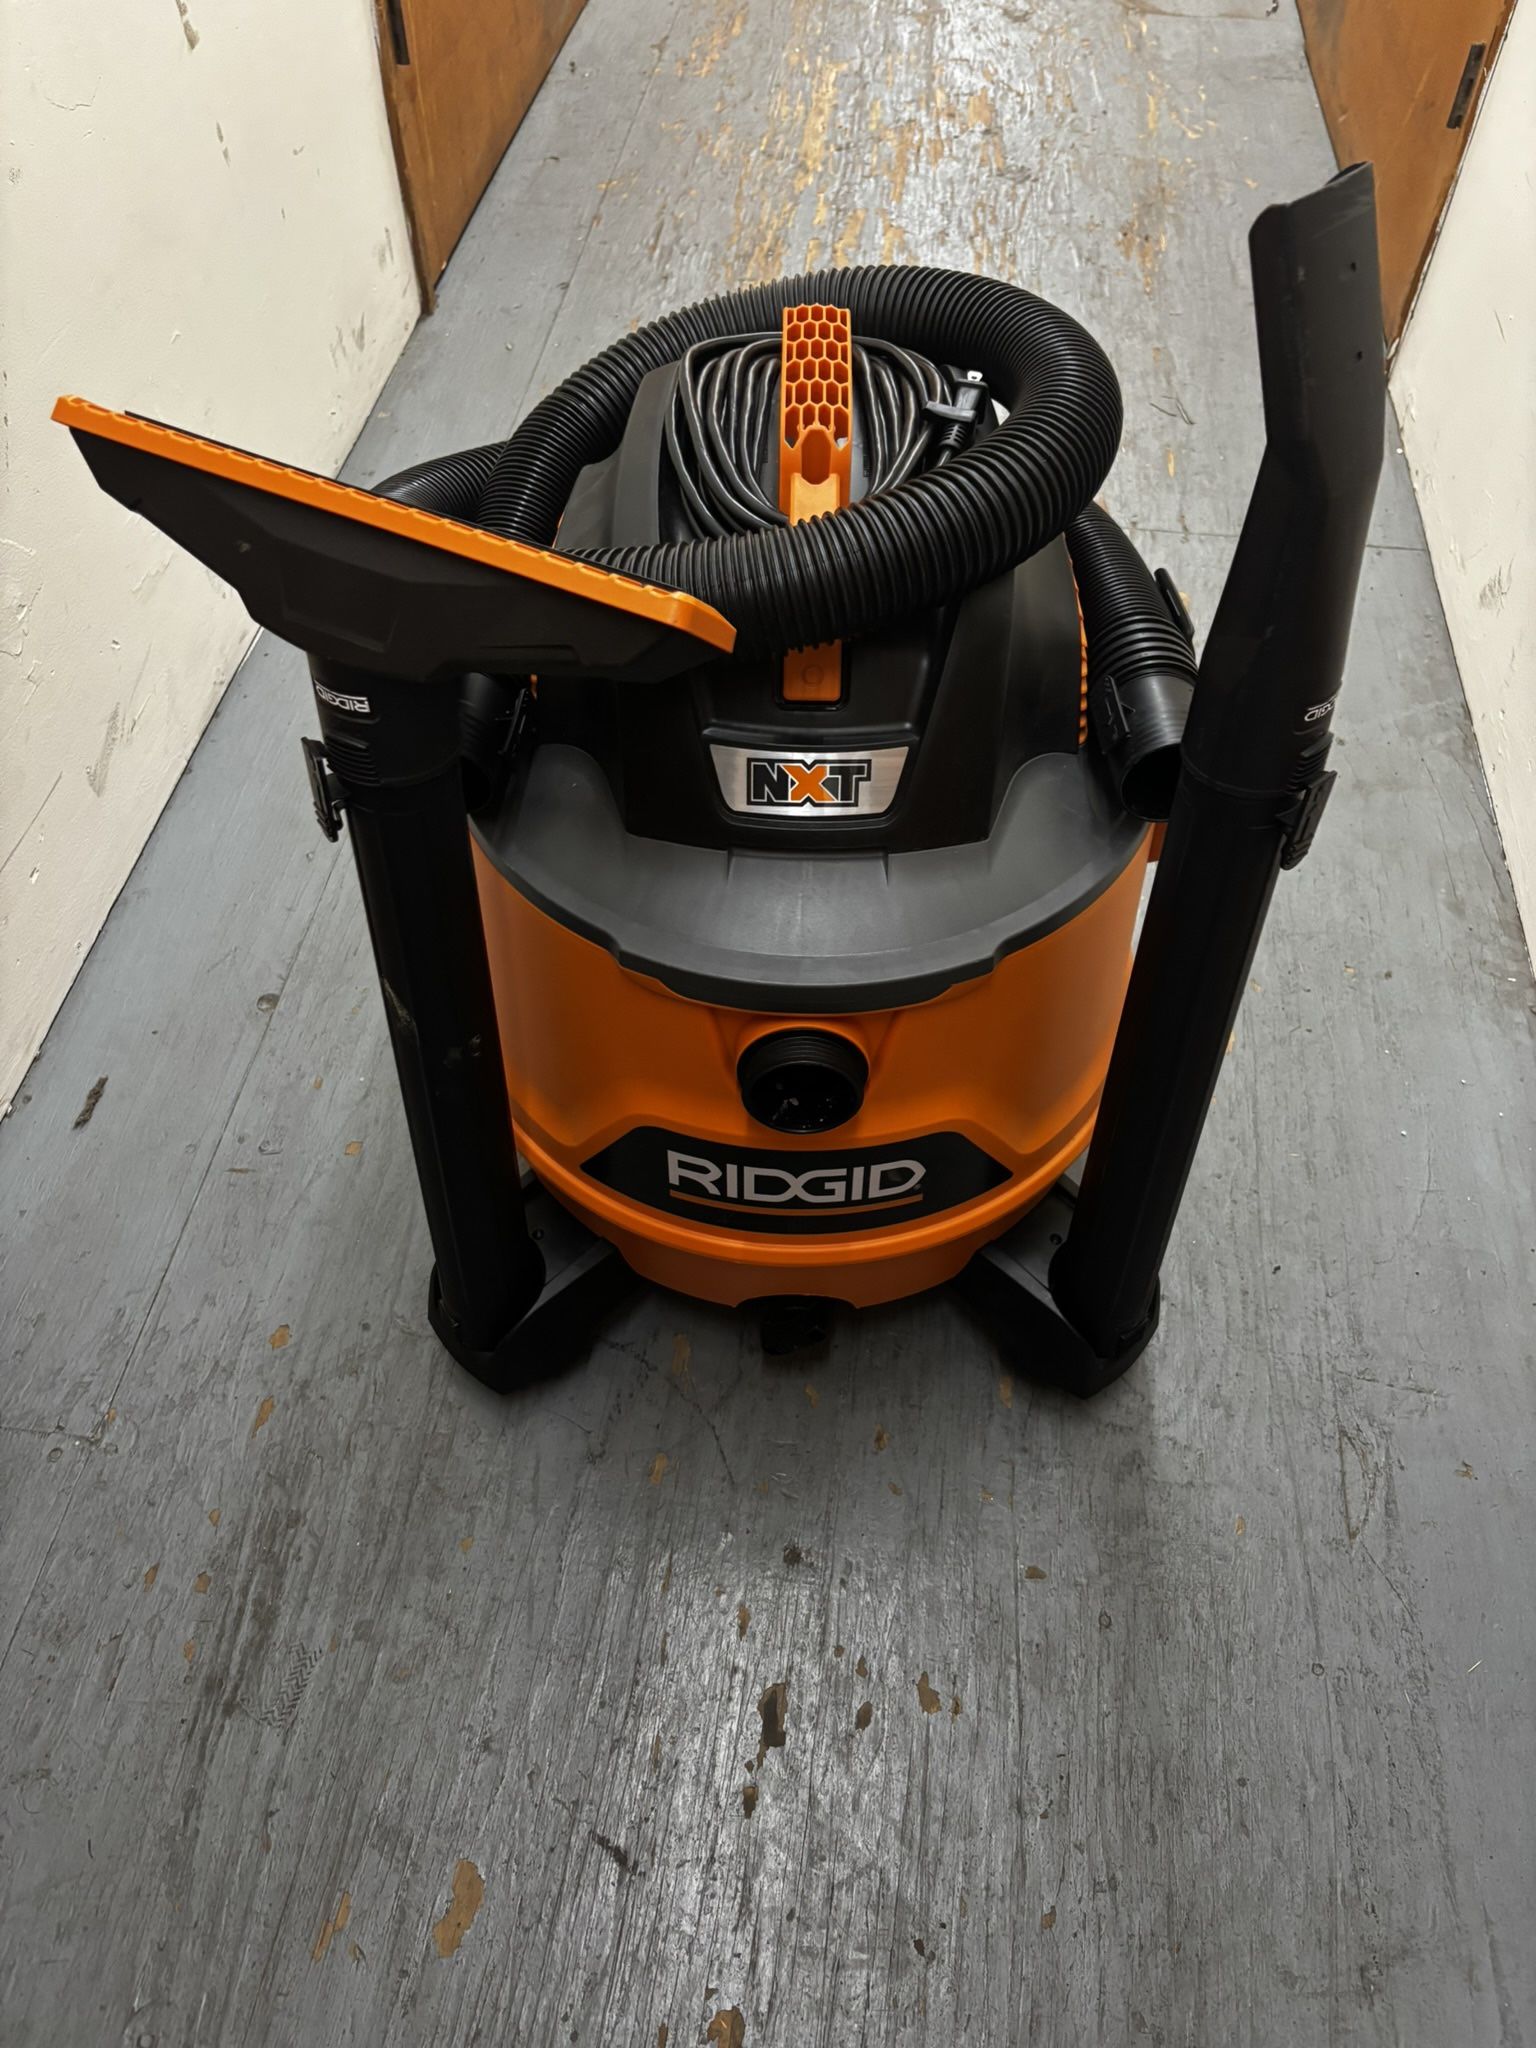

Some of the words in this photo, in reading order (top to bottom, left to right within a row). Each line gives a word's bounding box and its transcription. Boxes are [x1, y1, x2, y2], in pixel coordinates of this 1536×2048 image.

[316, 685, 371, 713] RIDGID
[746, 757, 872, 807] NXT
[667, 1149, 926, 1203] RIDGID
